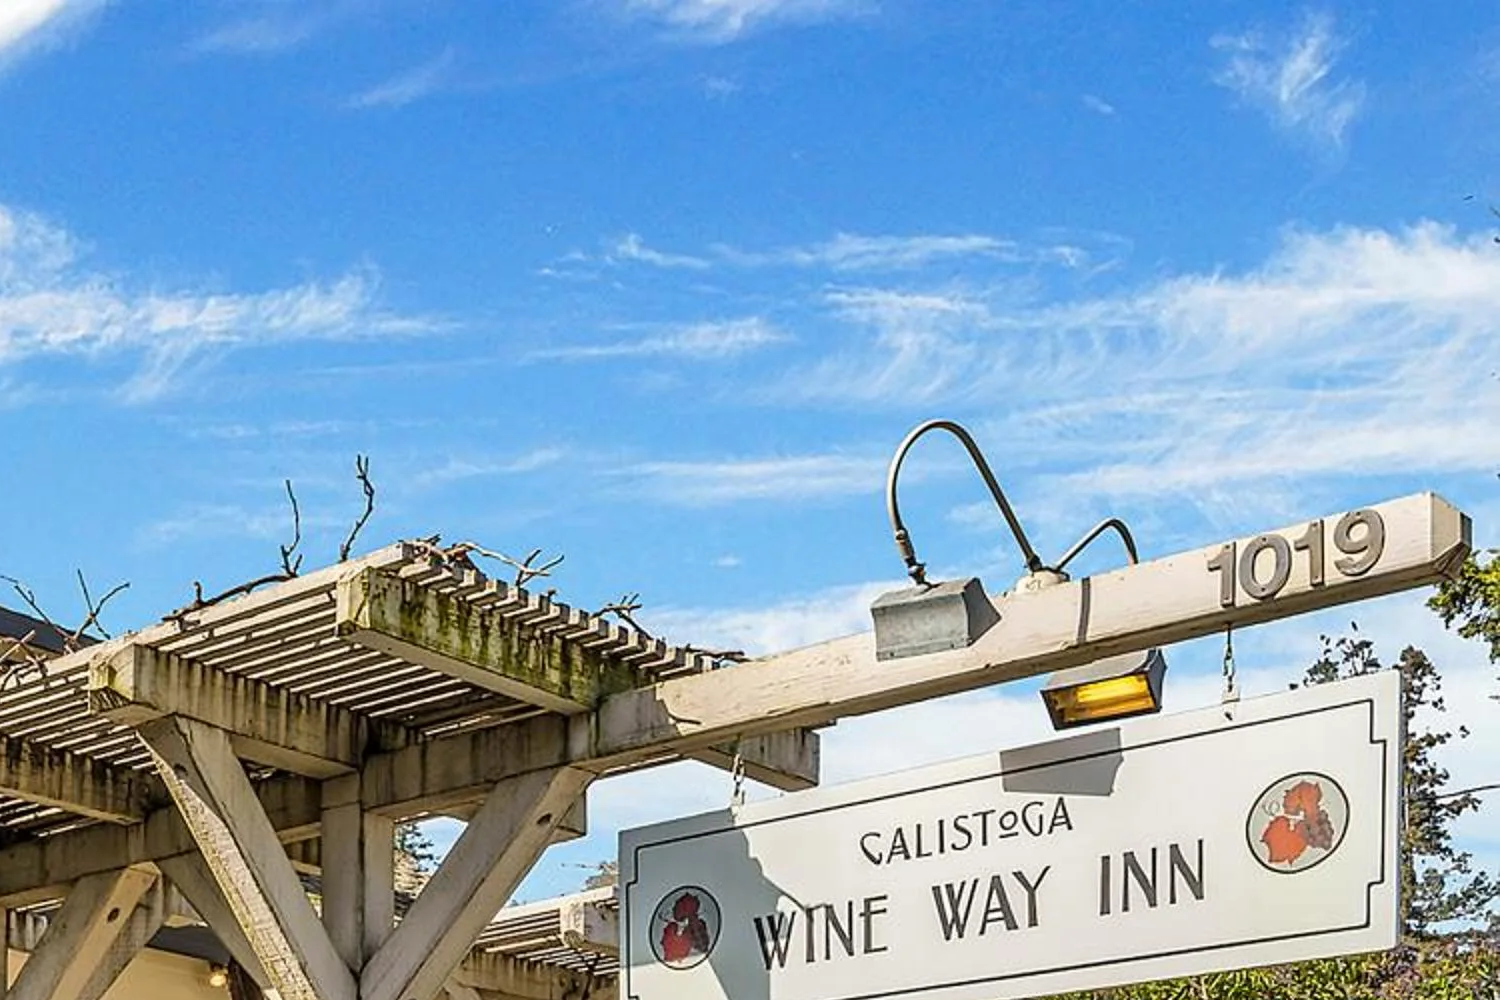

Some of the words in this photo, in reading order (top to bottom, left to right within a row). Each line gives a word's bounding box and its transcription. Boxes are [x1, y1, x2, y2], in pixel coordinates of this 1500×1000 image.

[1207, 508, 1385, 608] 1019
[859, 796, 1073, 866] CALISTOGA
[753, 894, 889, 971] WINE
[931, 865, 1051, 941] WAY
[1099, 838, 1206, 917] INN
